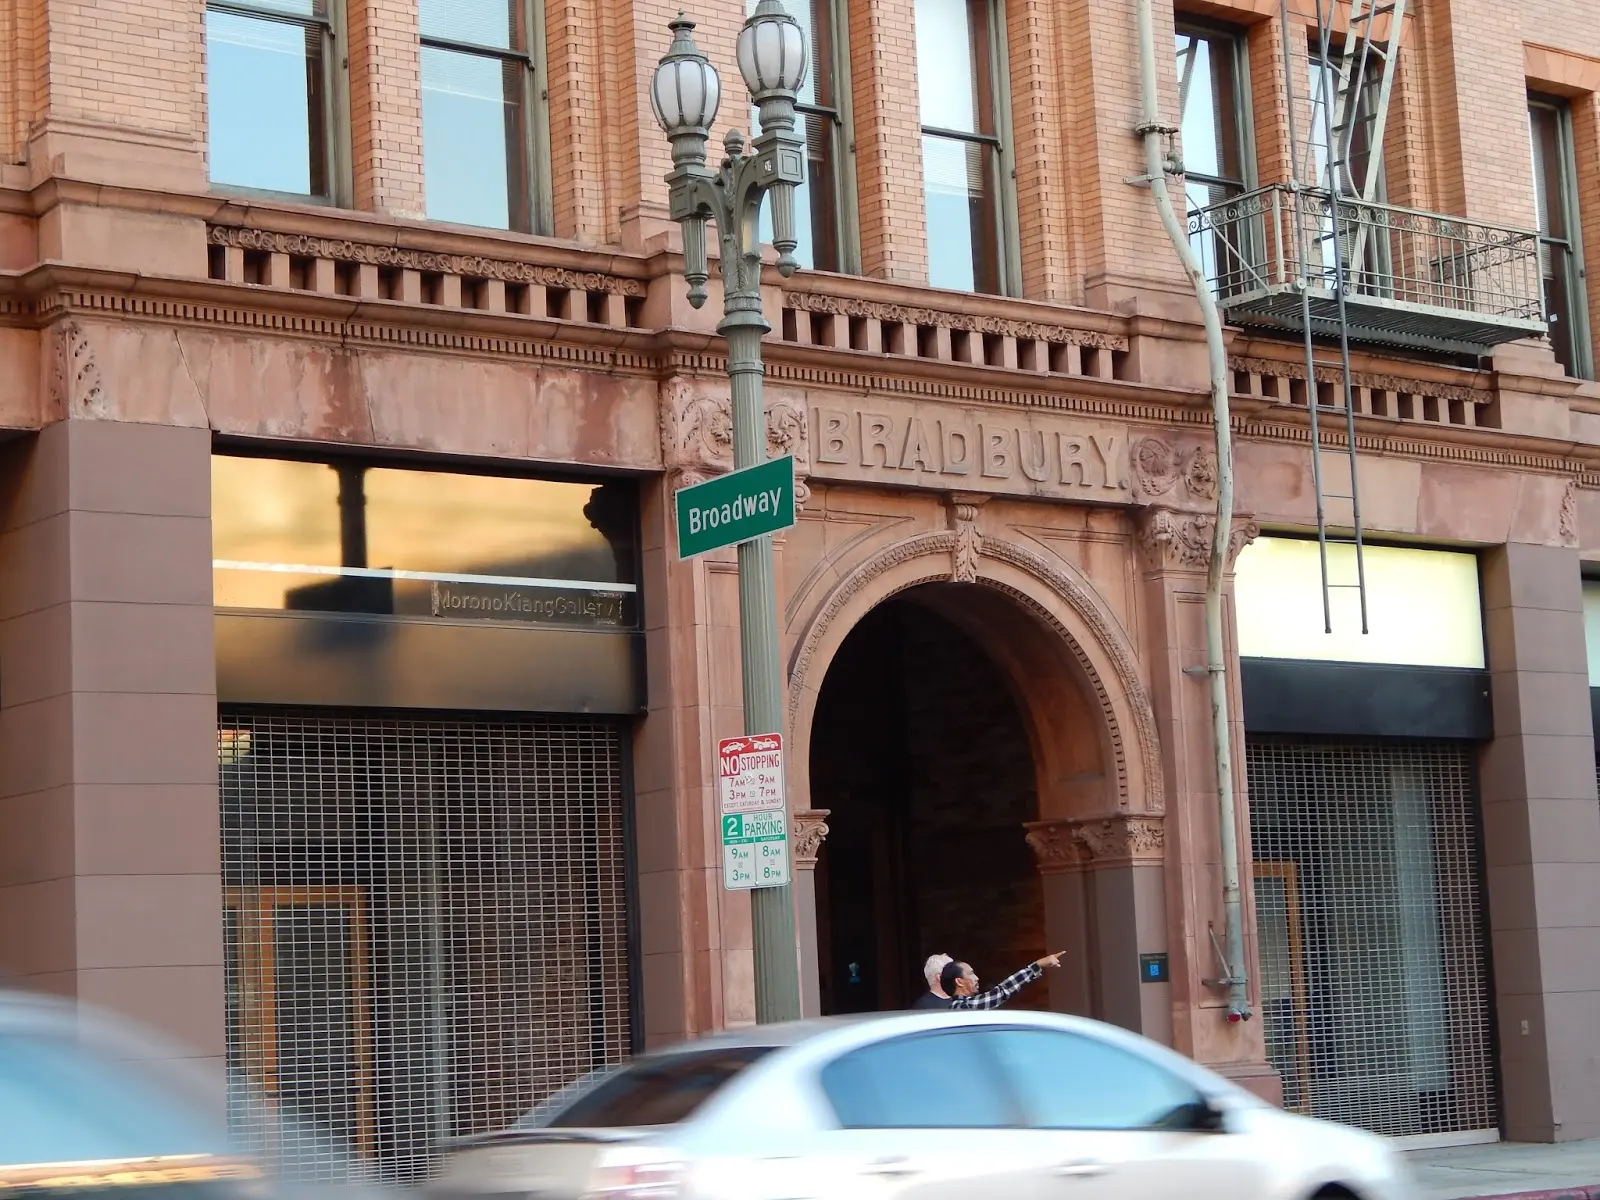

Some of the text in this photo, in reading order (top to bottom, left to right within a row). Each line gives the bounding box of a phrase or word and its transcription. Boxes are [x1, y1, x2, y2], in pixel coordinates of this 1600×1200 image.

[689, 487, 782, 535] Broadway
[721, 753, 780, 776] NO STOPPING
[727, 813, 773, 836] 2 HOUR
[744, 820, 783, 836] PARKING
